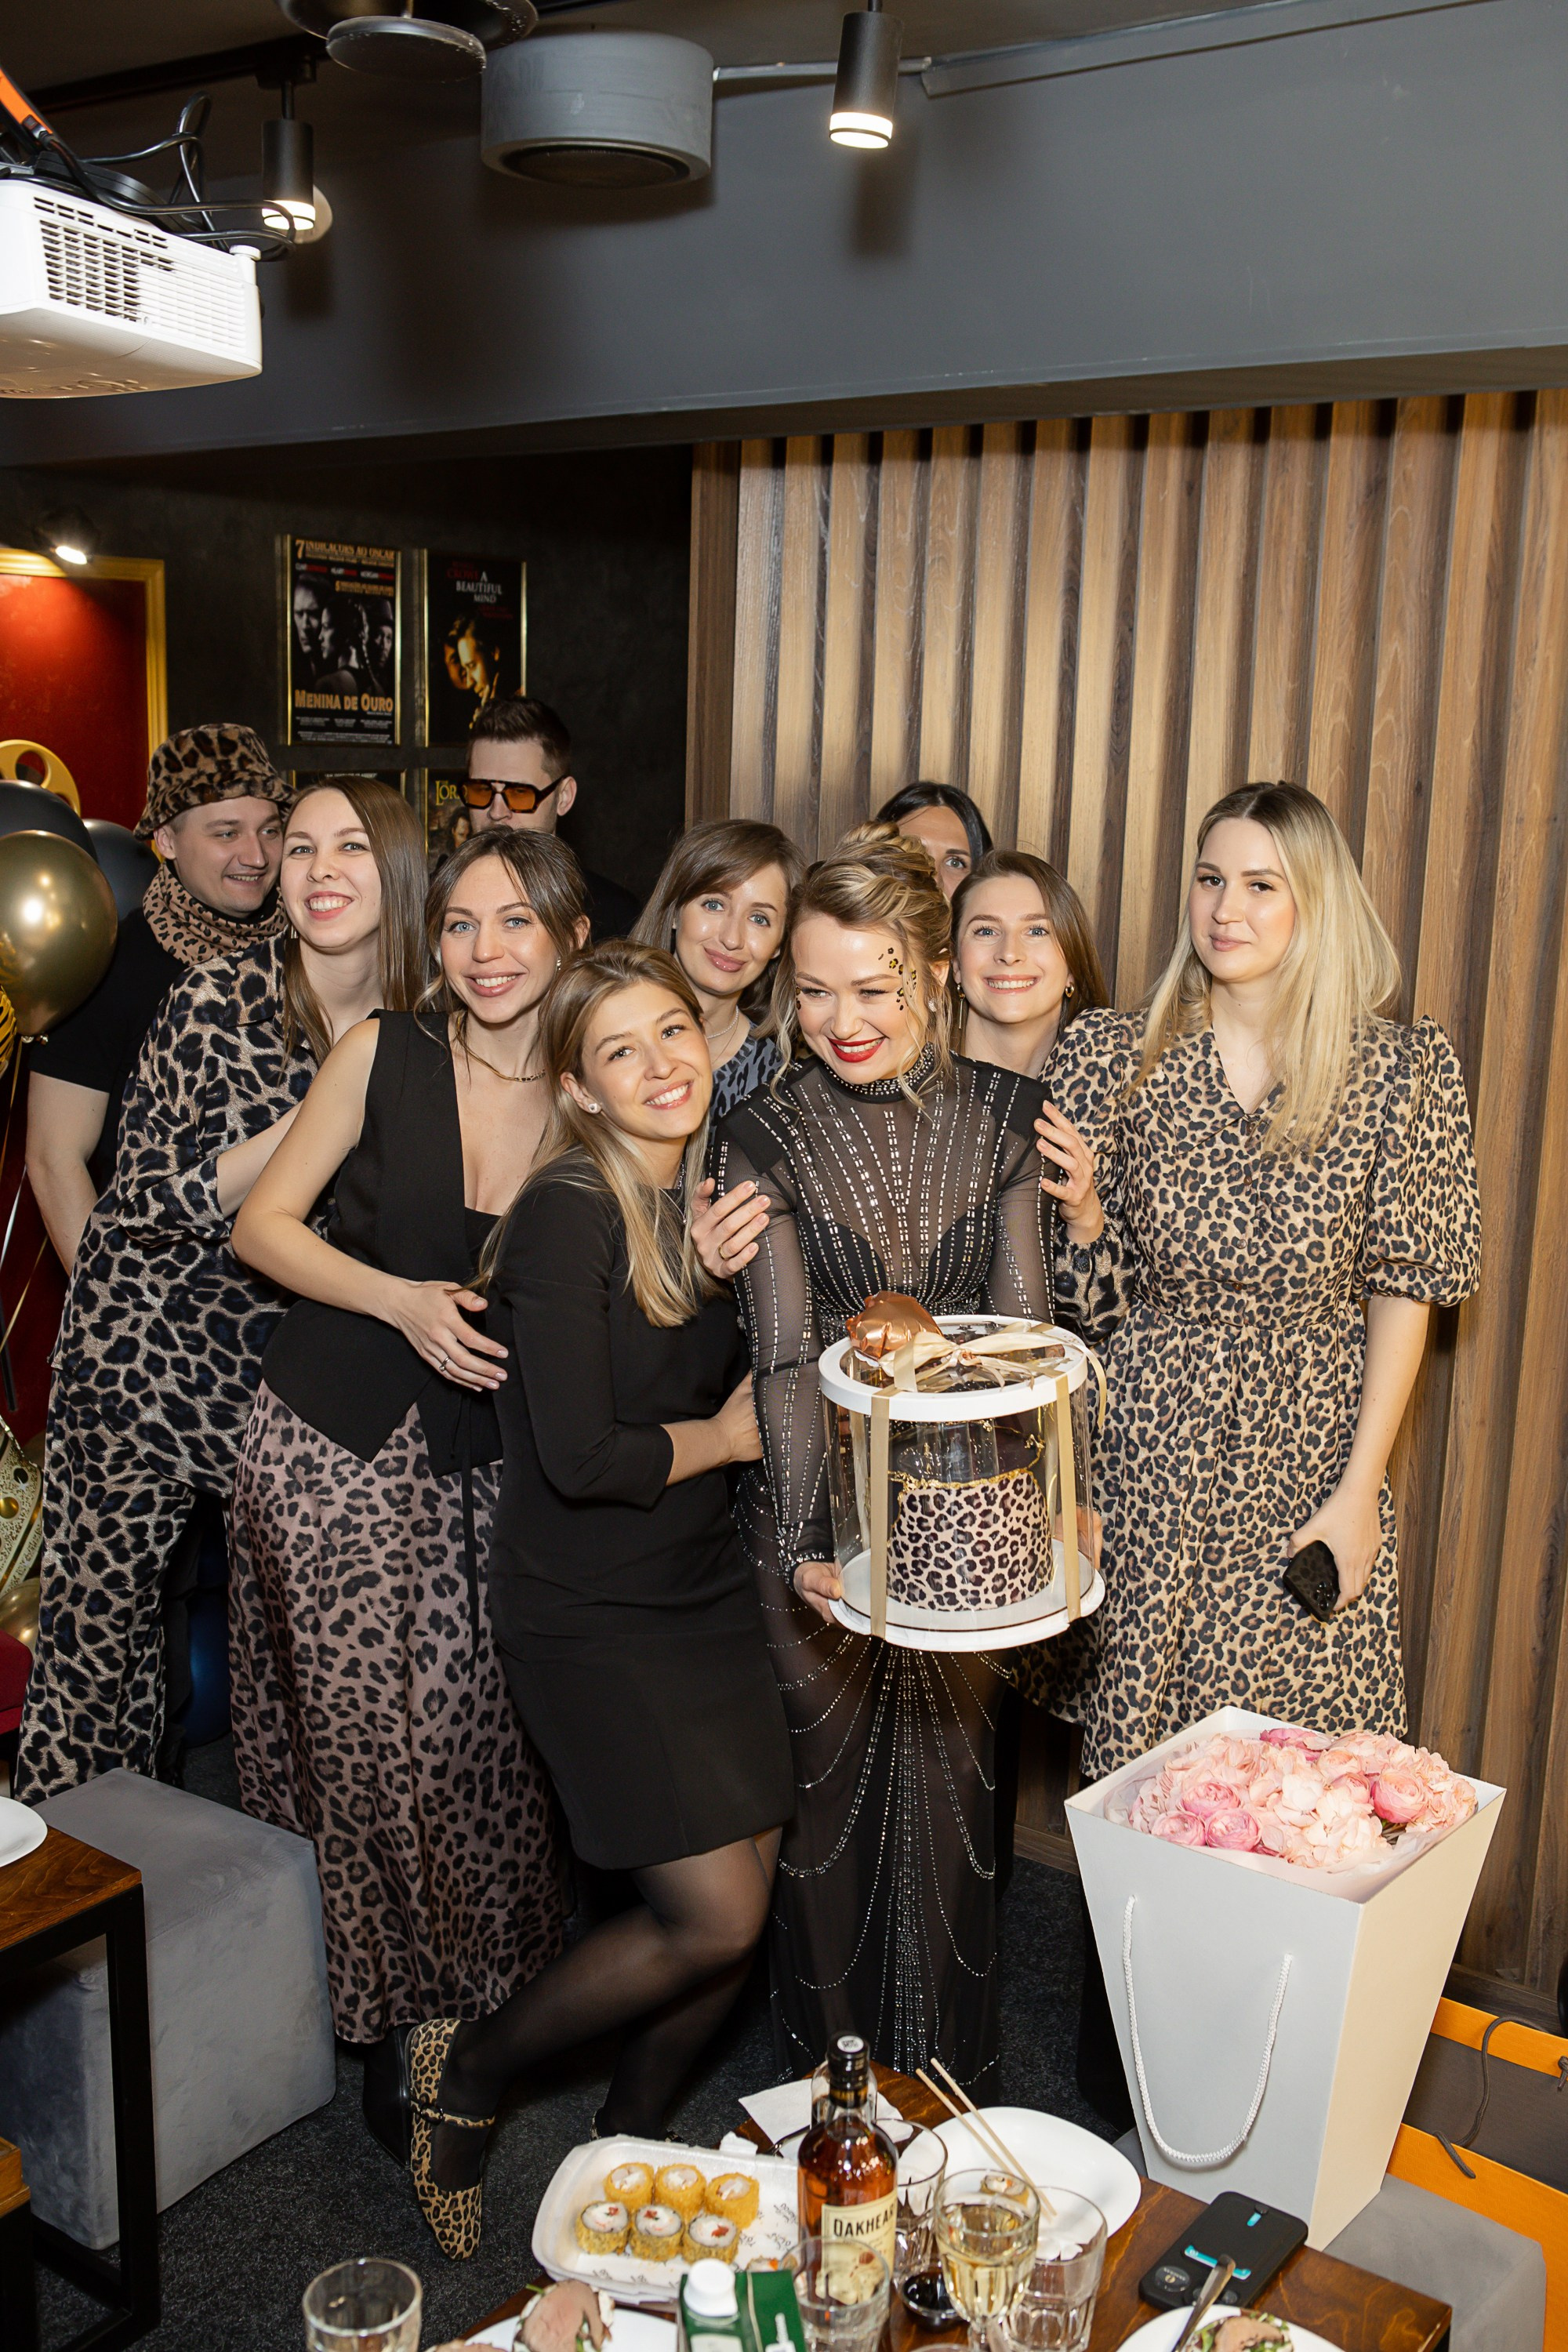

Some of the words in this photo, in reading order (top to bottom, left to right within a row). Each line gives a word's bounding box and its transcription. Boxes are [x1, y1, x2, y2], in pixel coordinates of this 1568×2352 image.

[296, 539, 305, 559] 7
[481, 571, 488, 582] A
[456, 580, 502, 595] BEAUTIFUL
[474, 593, 497, 604] MIND
[295, 689, 341, 710] MENINA
[343, 695, 358, 710] DE
[361, 692, 394, 713] OURO
[833, 2203, 894, 2237] OAKHEAR
